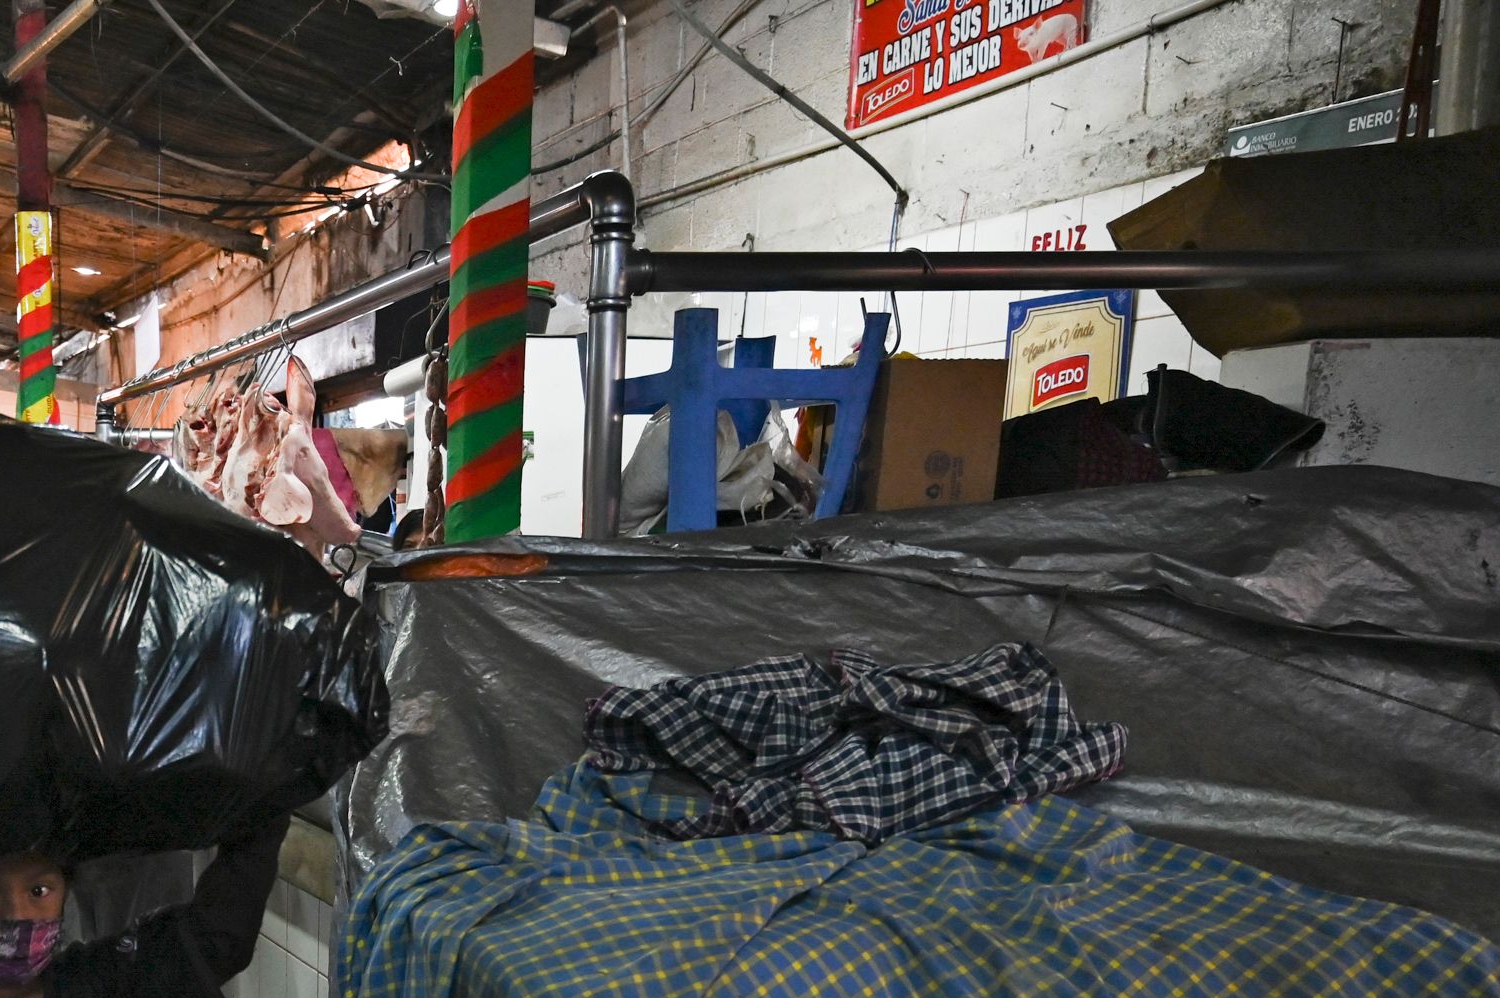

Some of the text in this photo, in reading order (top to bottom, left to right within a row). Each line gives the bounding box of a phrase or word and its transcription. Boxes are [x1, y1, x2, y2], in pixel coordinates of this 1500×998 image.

[857, 51, 879, 85] EN
[883, 27, 931, 76] CARNE
[935, 20, 947, 53] Y
[950, 5, 982, 48] SUS
[923, 34, 1002, 95] LO MEJOR
[866, 78, 910, 114] TOLEDO
[1348, 110, 1393, 133] ENERO
[1251, 132, 1276, 145] BANCO
[1037, 367, 1084, 397] TOLEDO
